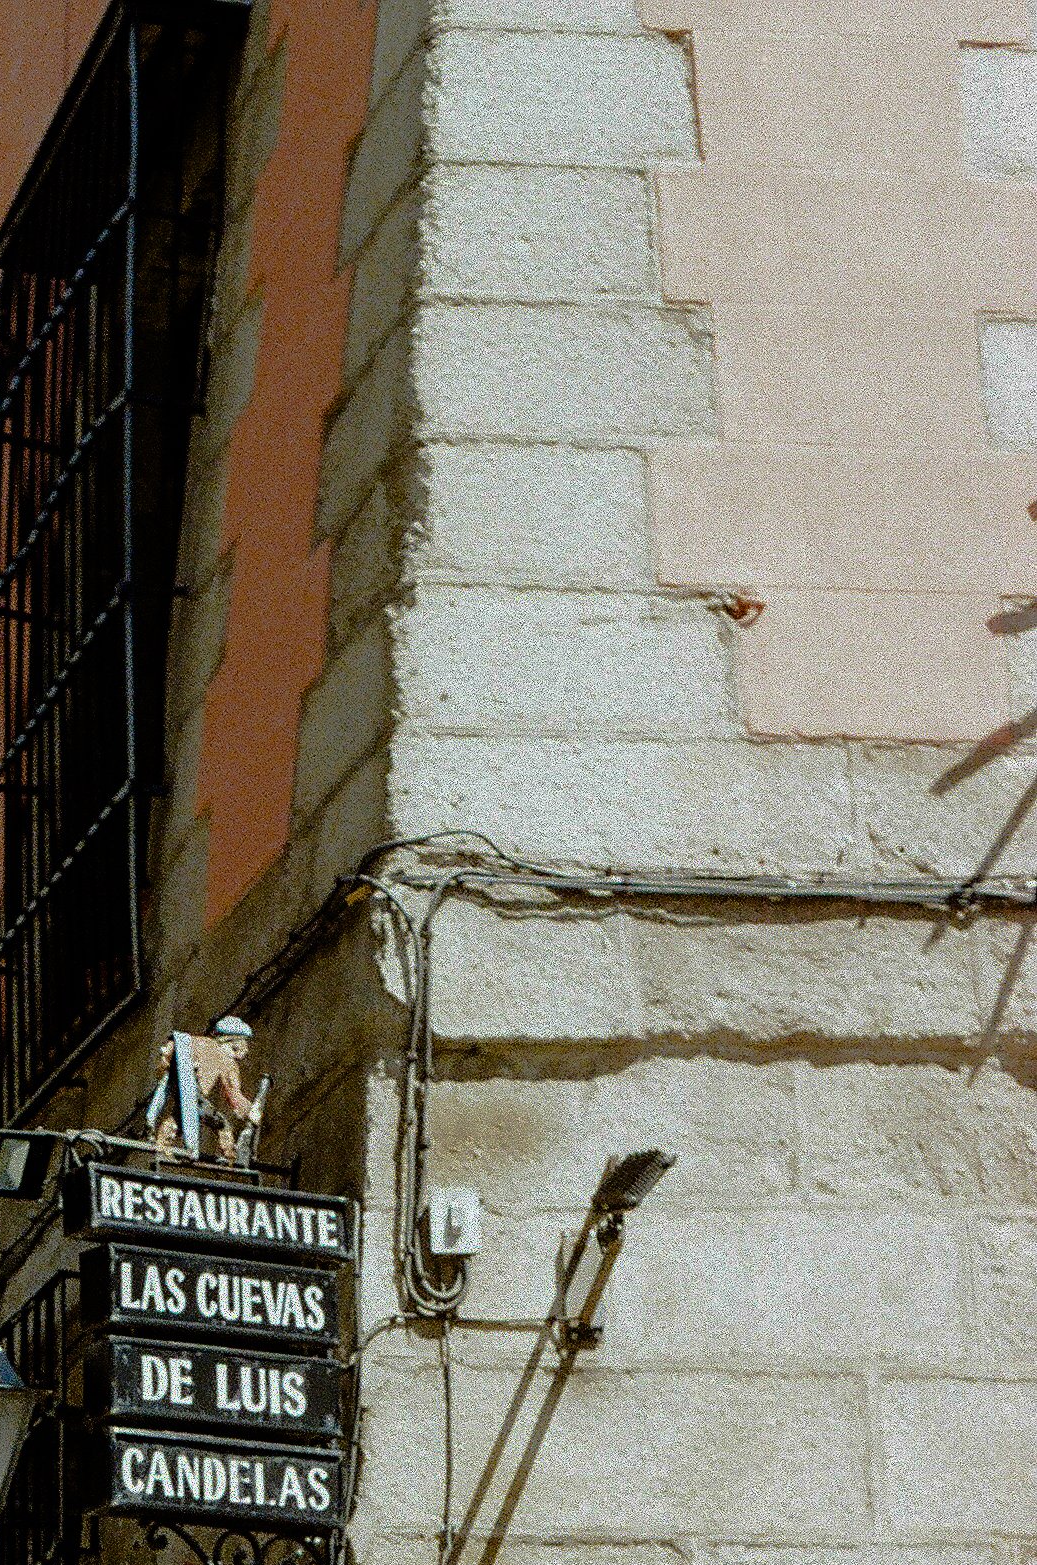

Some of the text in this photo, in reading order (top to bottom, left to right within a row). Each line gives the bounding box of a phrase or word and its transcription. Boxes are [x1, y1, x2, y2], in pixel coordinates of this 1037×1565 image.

[98, 1178, 342, 1250] RESTAURANTE
[119, 1262, 326, 1332] LAS CUEVAS
[140, 1355, 308, 1418] DE LUIS
[120, 1446, 331, 1513] CANDELAS
